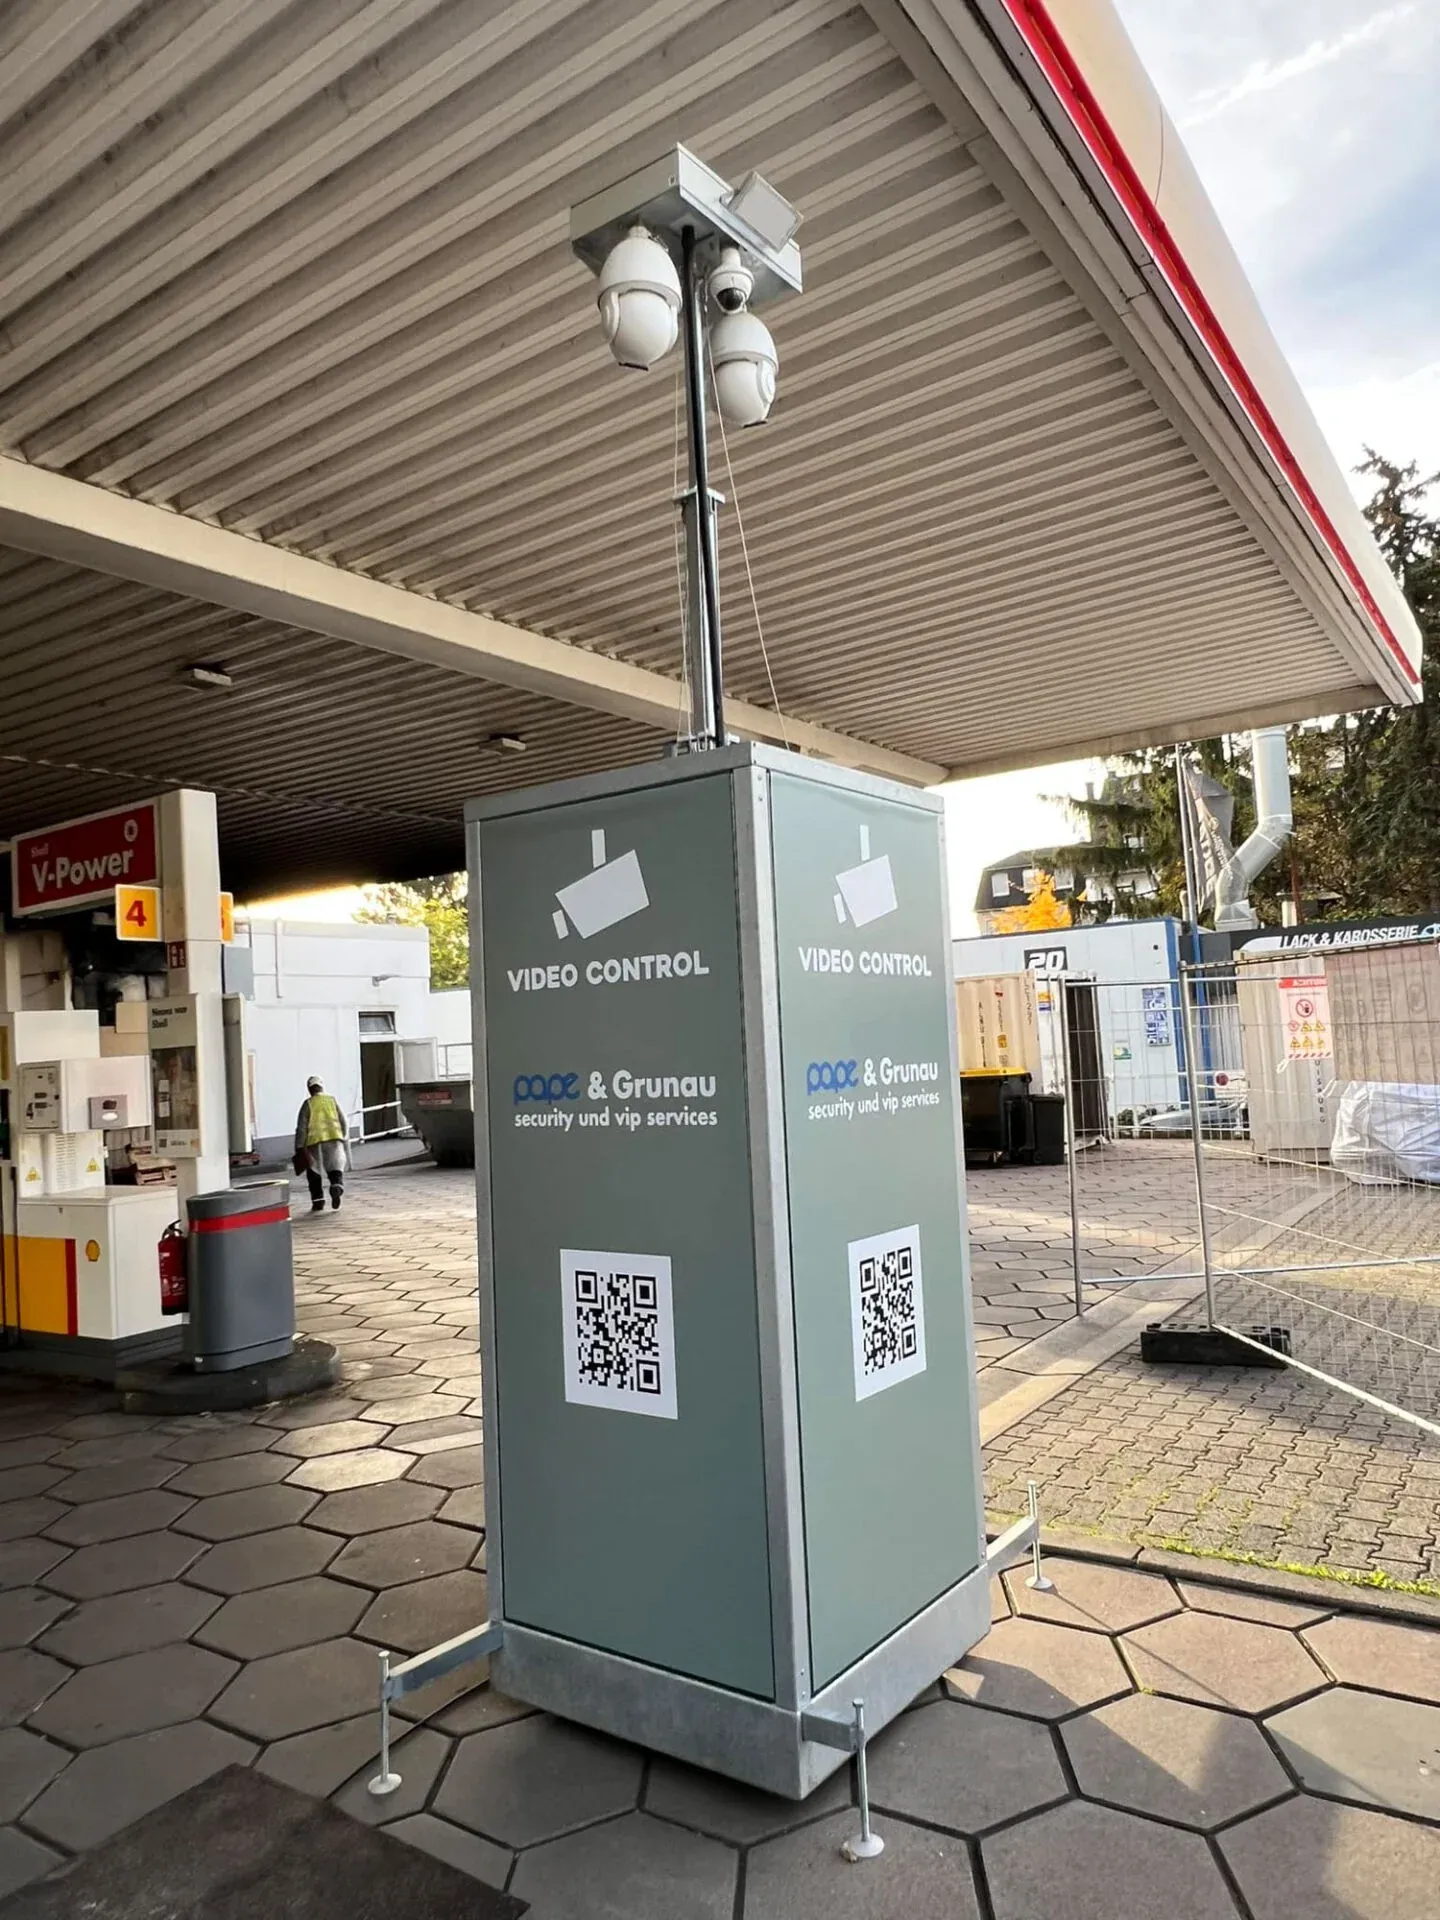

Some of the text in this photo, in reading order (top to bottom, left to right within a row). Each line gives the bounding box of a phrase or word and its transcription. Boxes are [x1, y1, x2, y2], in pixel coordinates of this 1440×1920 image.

[32, 849, 134, 893] V-Power
[125, 900, 147, 928] 4
[1283, 933, 1318, 949] LACK
[1320, 932, 1331, 946] &
[507, 950, 710, 992] VIDEO CONTROL
[798, 946, 932, 978] VIDEO CONTROL
[587, 1070, 608, 1100] &
[612, 1069, 717, 1100] Grunau
[863, 1058, 877, 1086] &
[879, 1056, 939, 1085] Grunau
[514, 1105, 718, 1132] security und vip services
[808, 1089, 940, 1121] security und vip services
